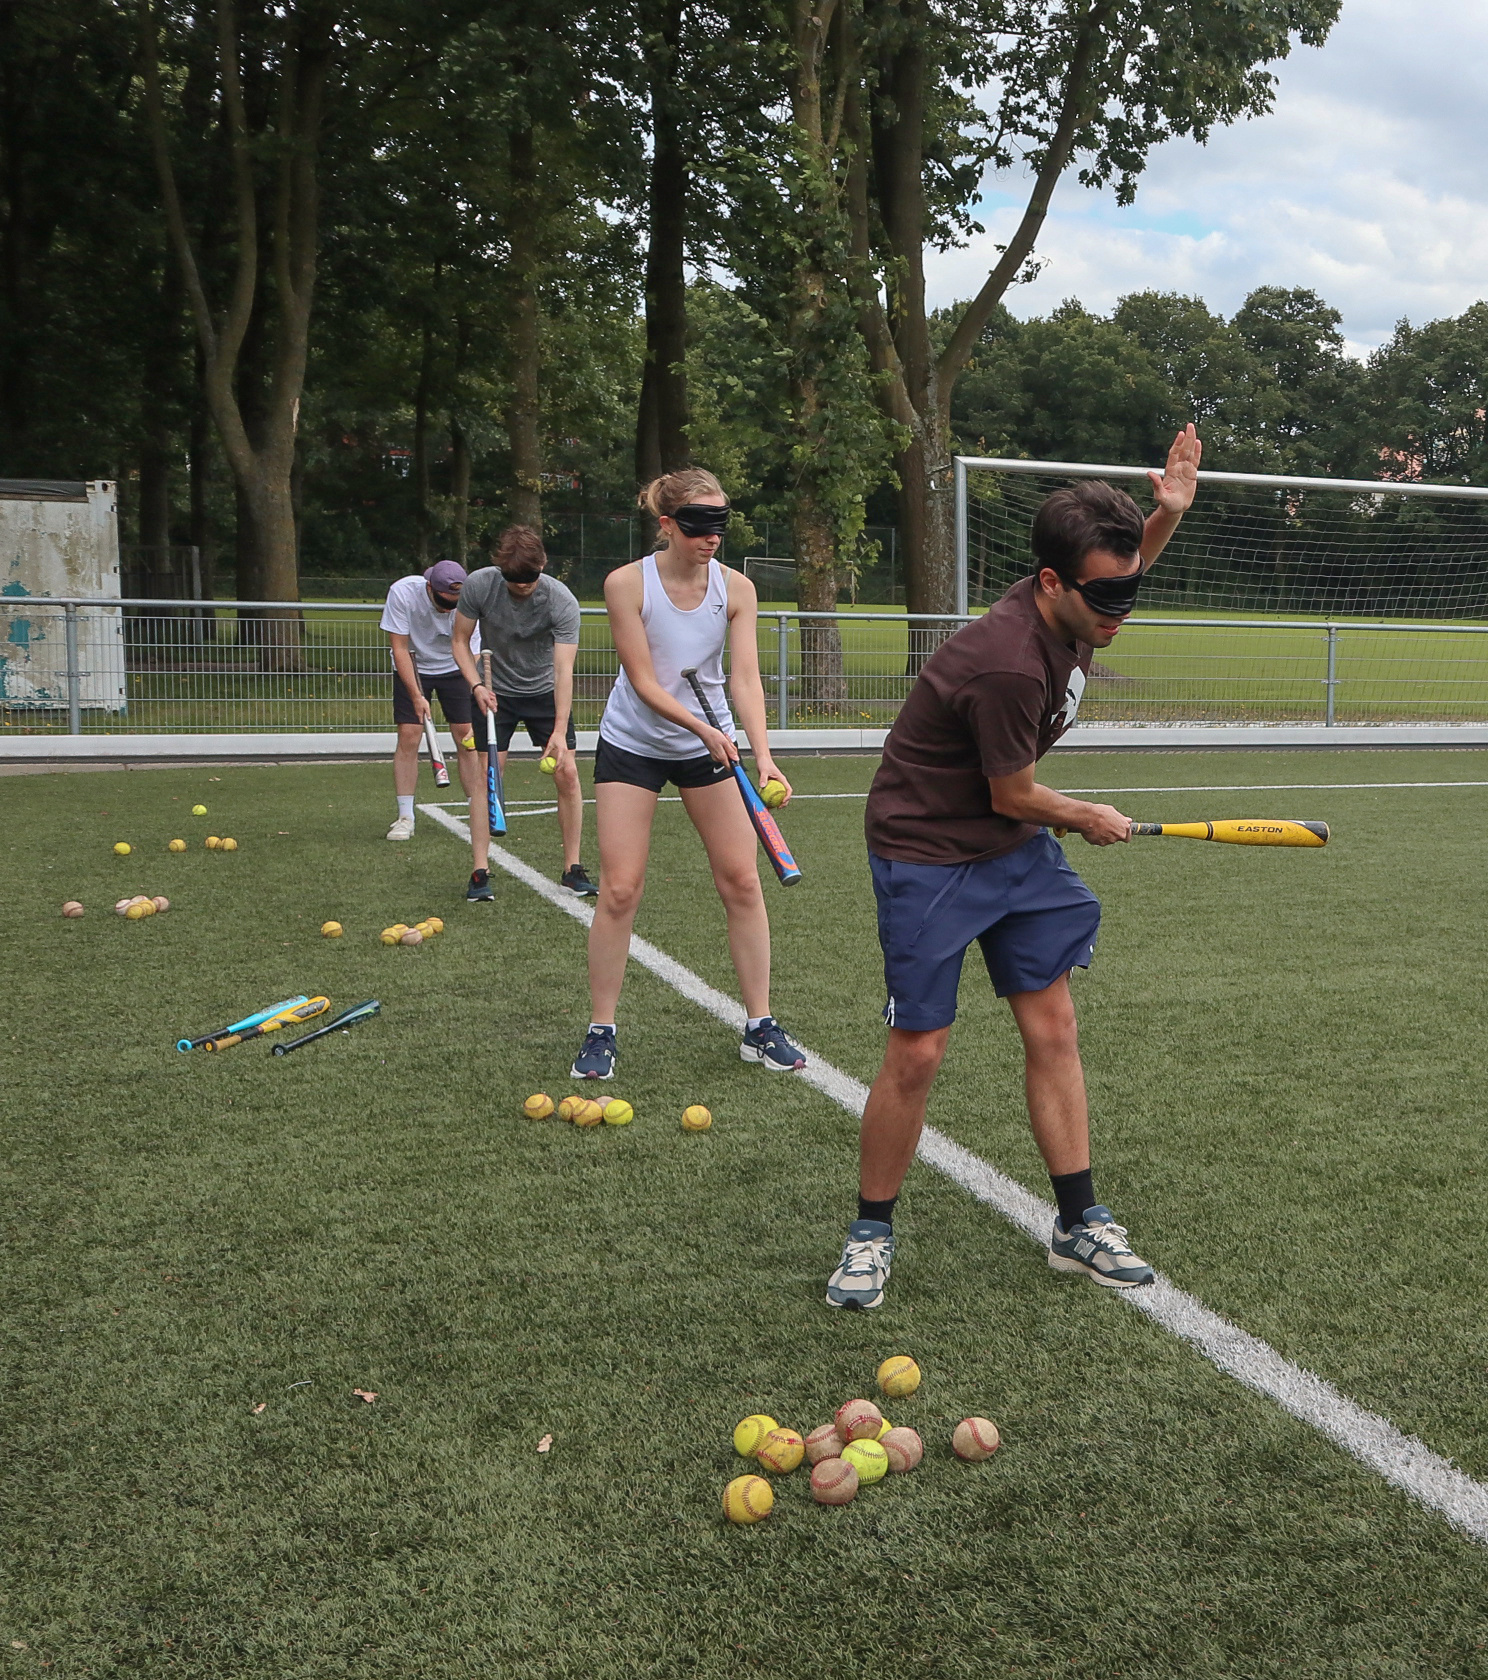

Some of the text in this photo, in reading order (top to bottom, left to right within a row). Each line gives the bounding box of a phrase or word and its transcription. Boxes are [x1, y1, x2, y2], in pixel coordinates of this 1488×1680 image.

[756, 809, 785, 854] SLUGGER
[1237, 825, 1283, 833] EASTON
[1074, 1238, 1096, 1258] N
